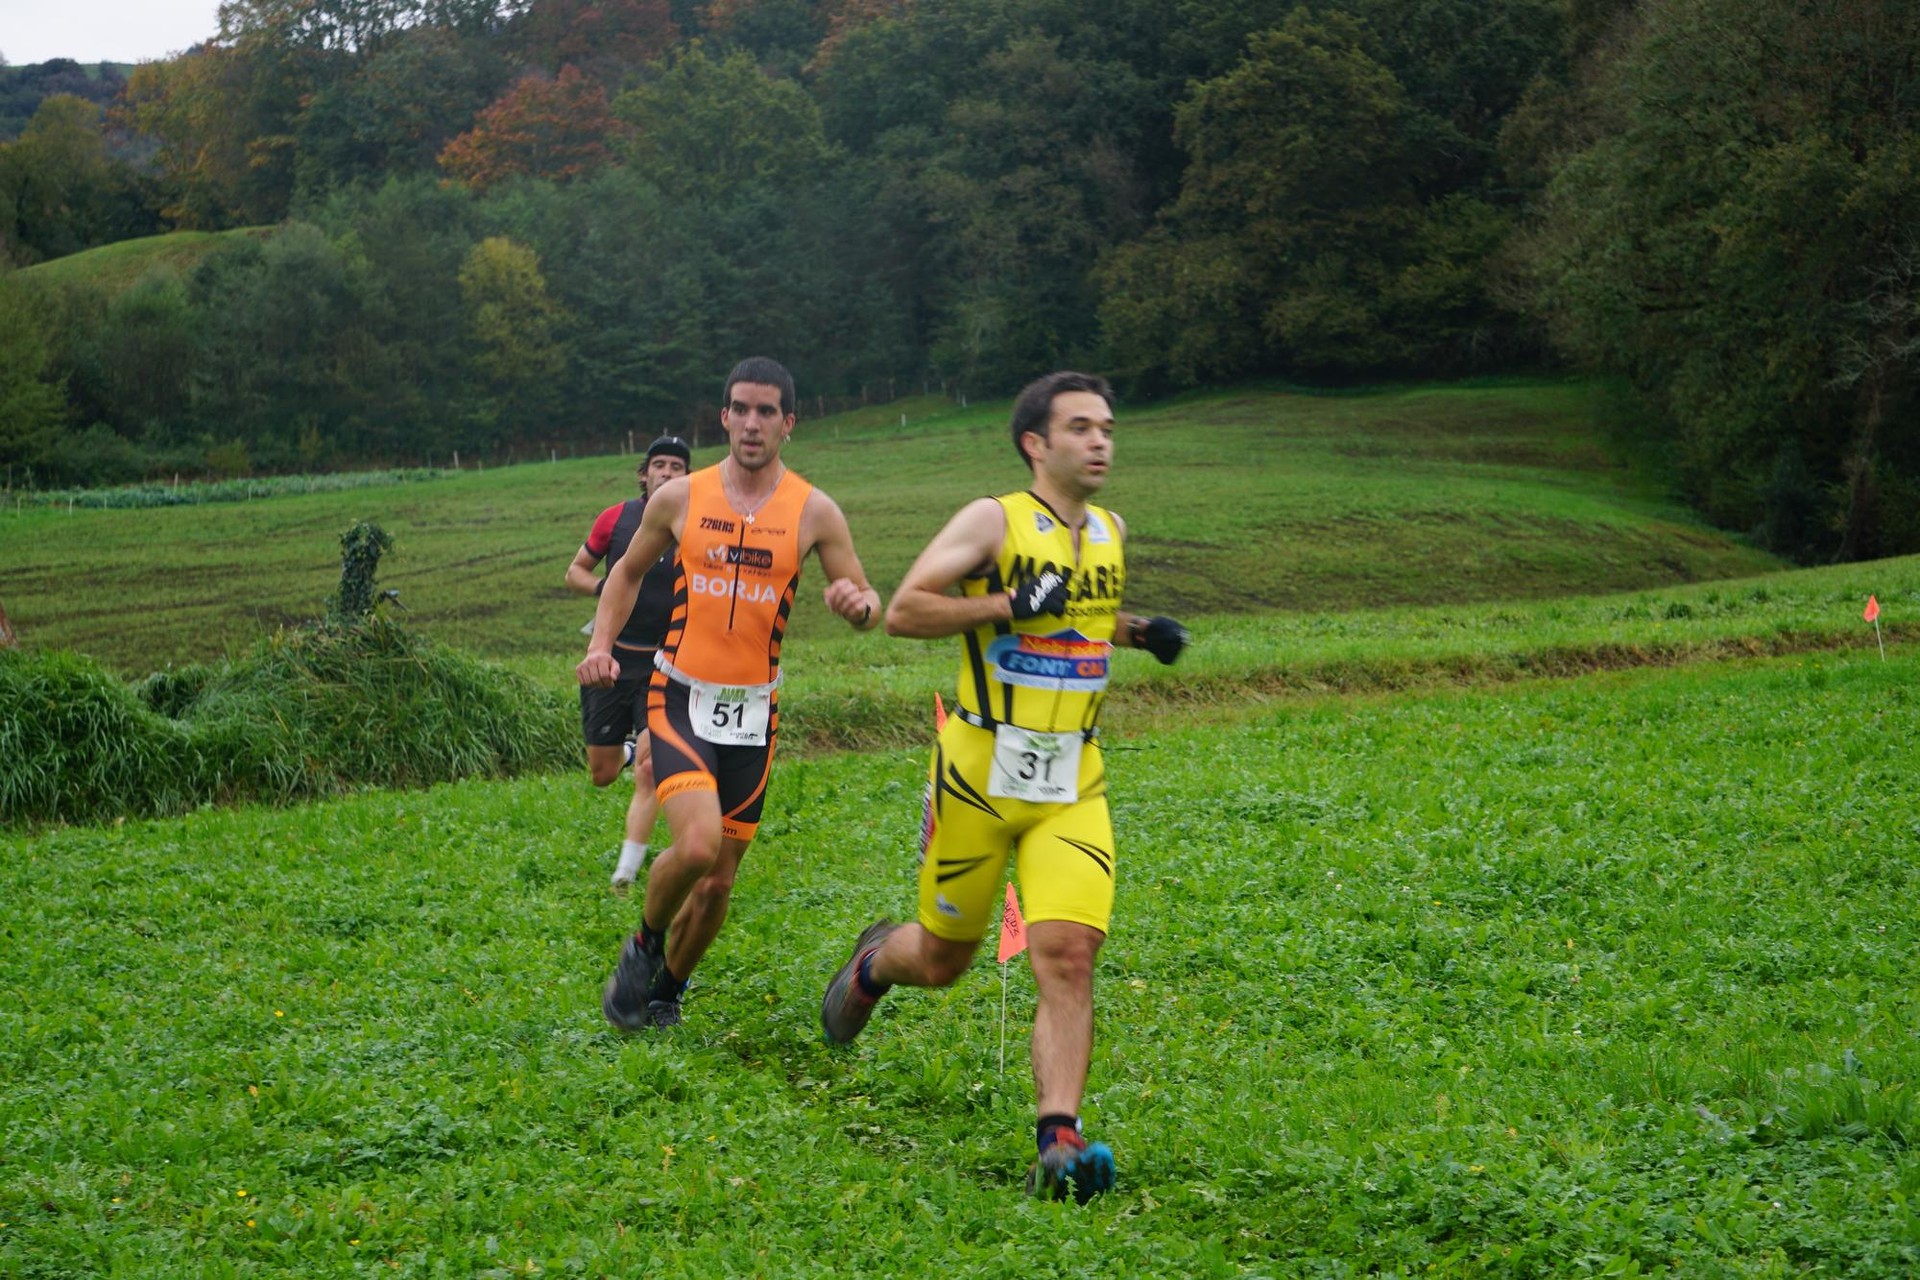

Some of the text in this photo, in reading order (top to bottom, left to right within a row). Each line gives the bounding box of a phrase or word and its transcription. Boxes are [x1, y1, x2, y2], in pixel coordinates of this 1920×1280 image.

[700, 516, 735, 534] 226ERS
[692, 573, 777, 604] BORJA
[1007, 652, 1072, 677] FONT
[712, 702, 745, 729] 51
[1018, 752, 1056, 783] 31
